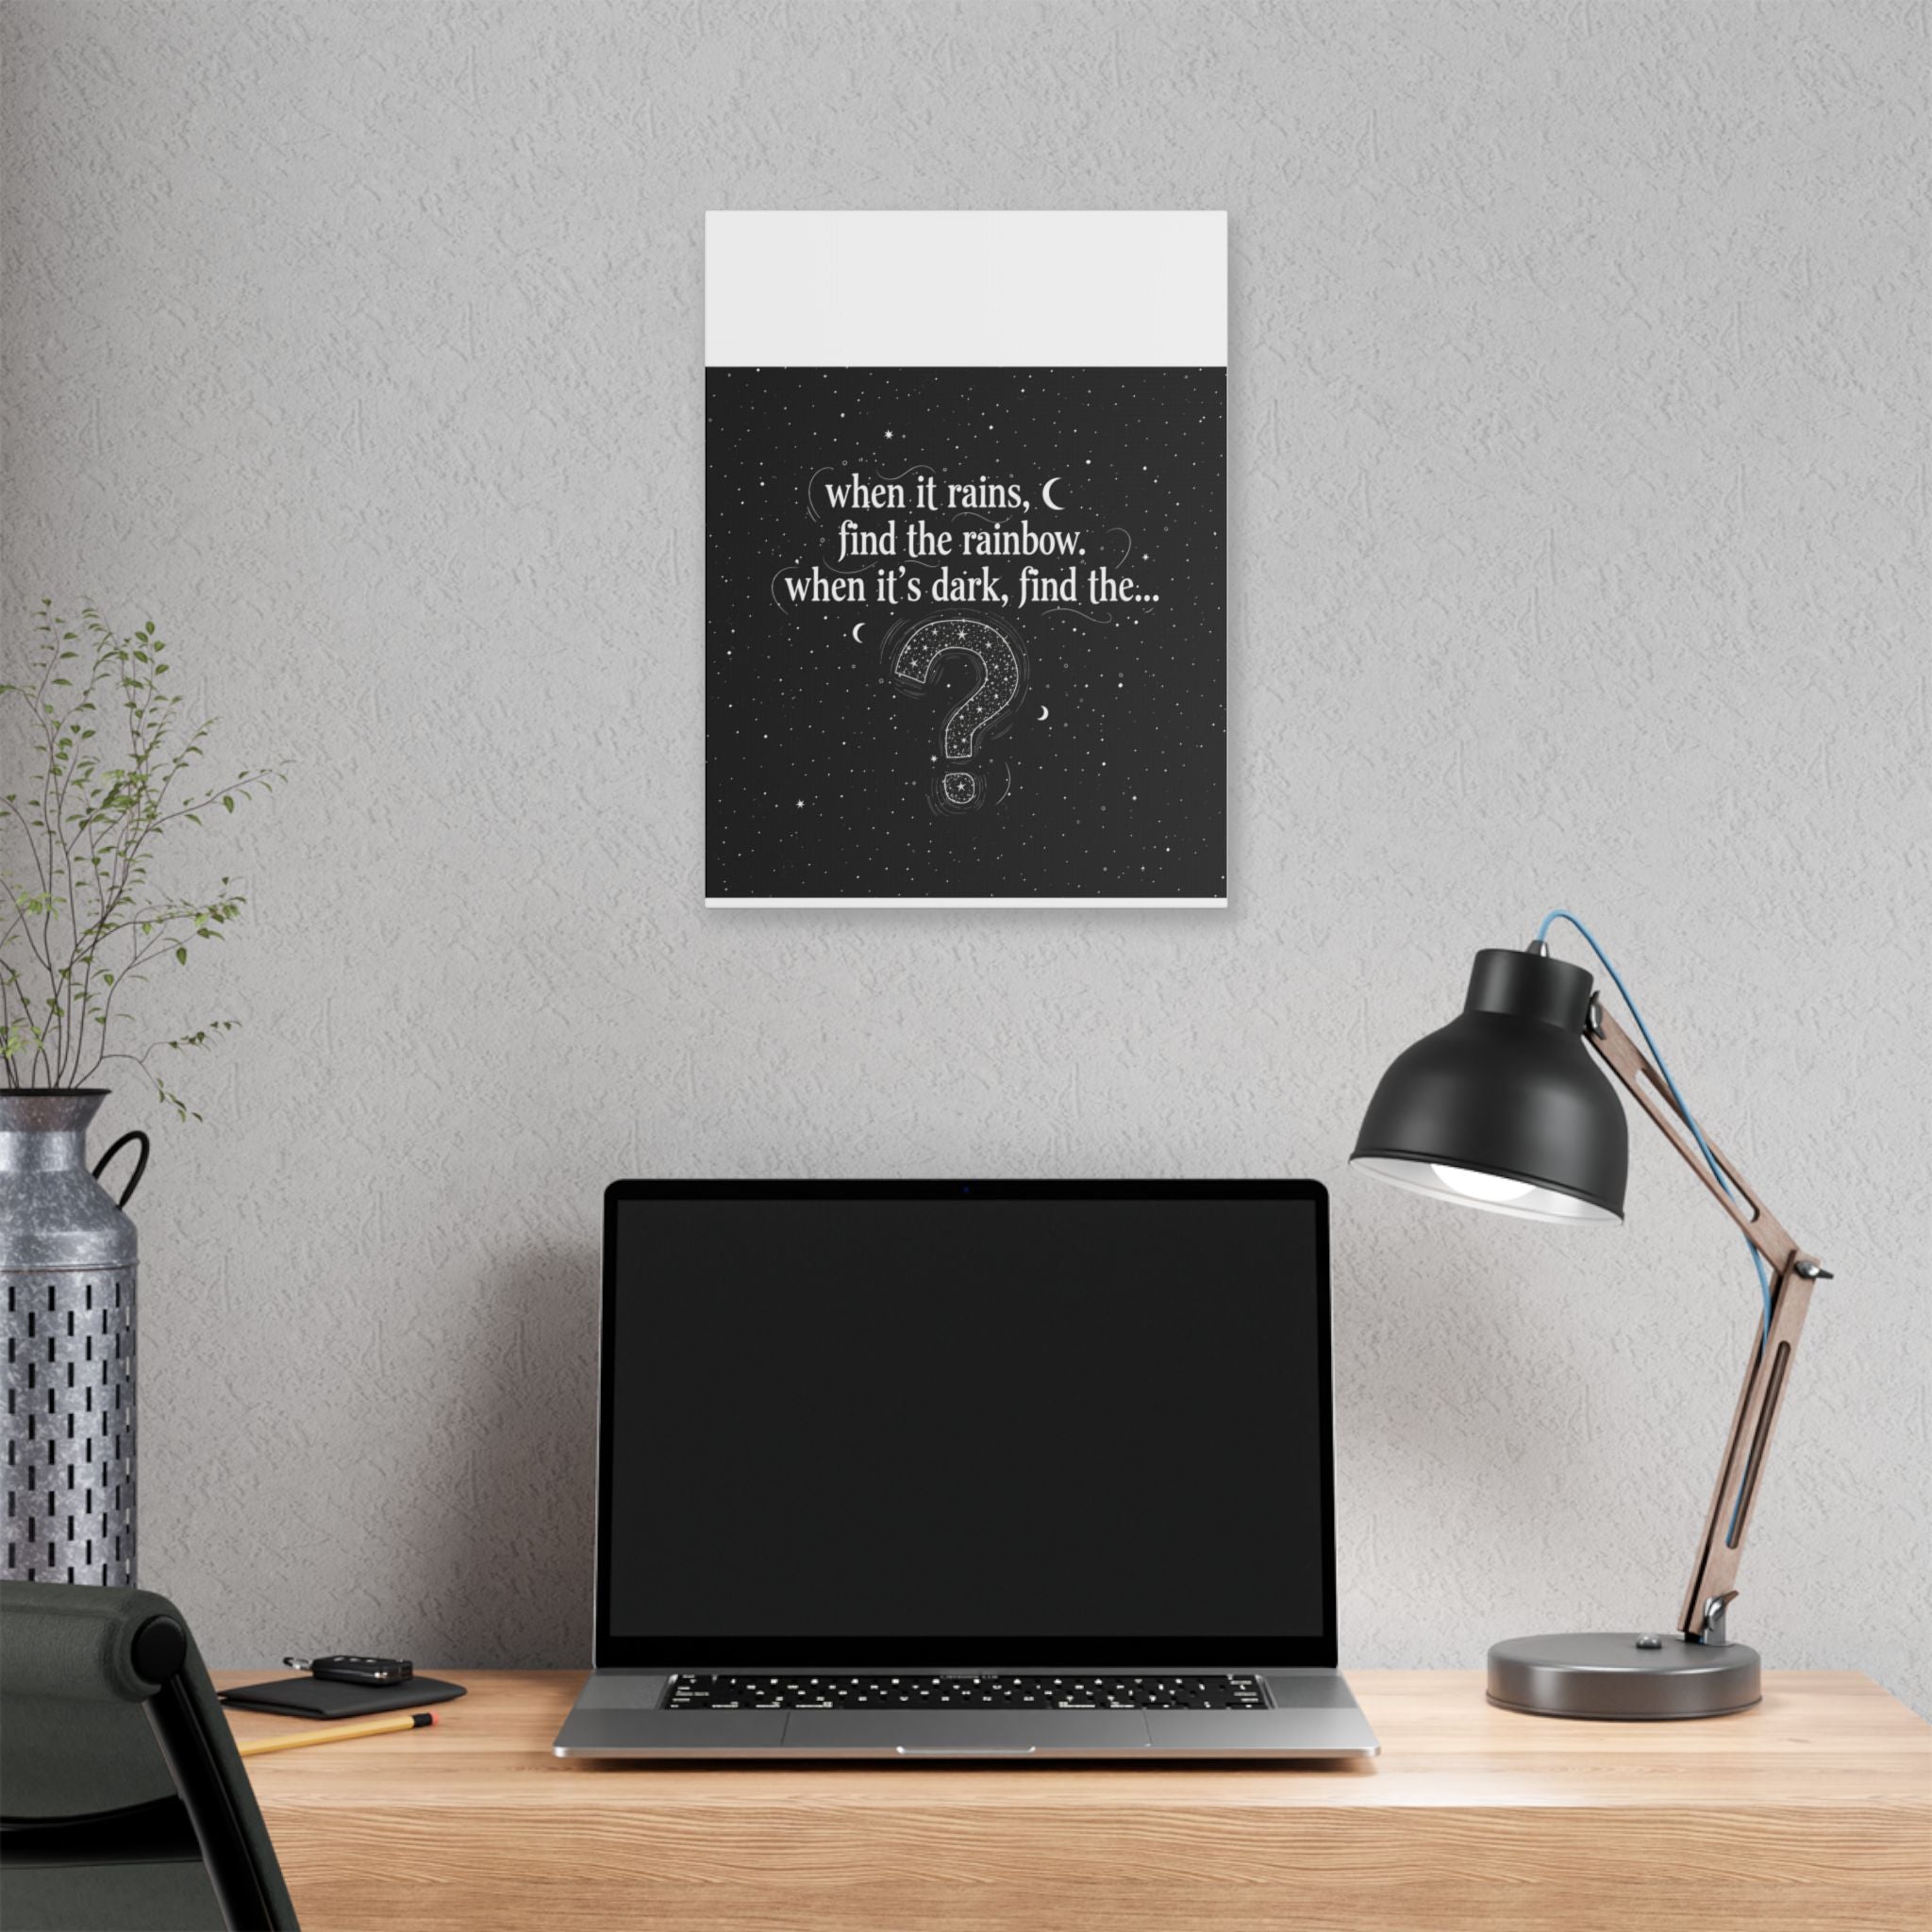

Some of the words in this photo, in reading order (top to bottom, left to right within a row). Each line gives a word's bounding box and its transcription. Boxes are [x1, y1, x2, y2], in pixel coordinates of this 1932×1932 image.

[824, 473, 906, 508] when
[915, 475, 939, 511] it
[947, 475, 1030, 513] rains,
[838, 519, 896, 562] find
[906, 520, 953, 558] the
[962, 520, 1086, 556] rainbow.
[784, 566, 866, 602] when
[931, 566, 1008, 608] dark,
[1018, 565, 1077, 608] find
[1088, 566, 1159, 605] the...
[894, 619, 1019, 805] ?
